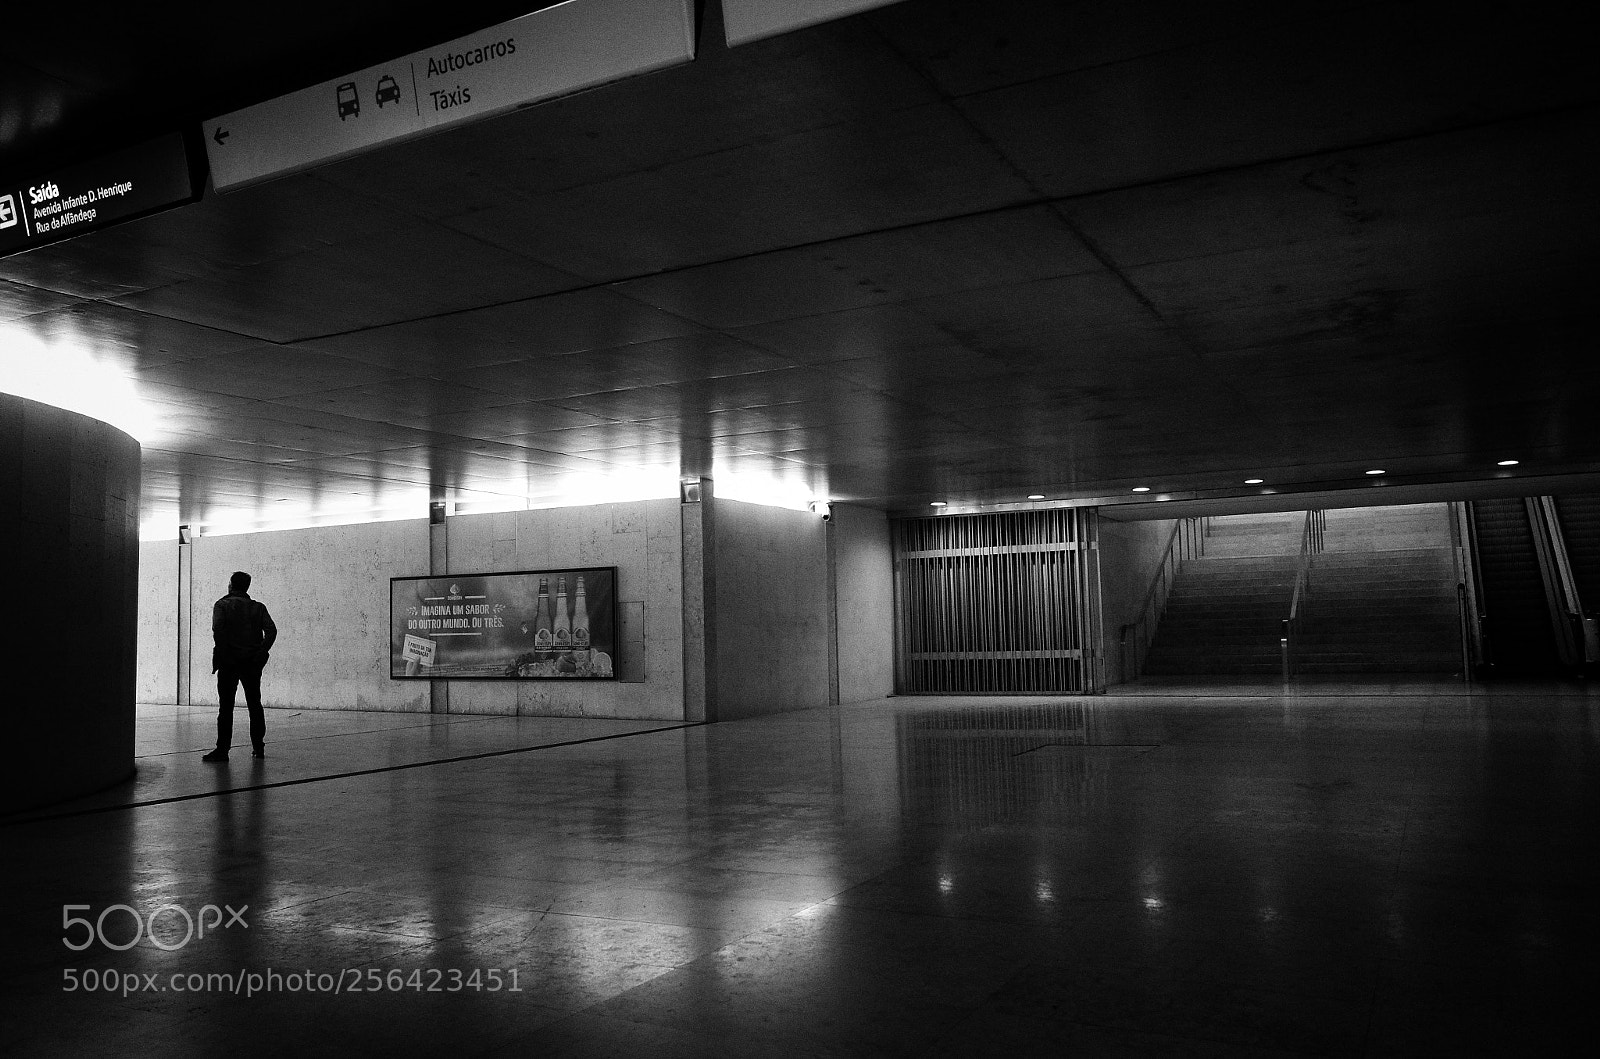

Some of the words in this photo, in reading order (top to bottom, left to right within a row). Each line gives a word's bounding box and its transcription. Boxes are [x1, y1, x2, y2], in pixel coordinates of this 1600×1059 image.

[427, 37, 516, 78] Autocarros
[430, 85, 471, 112] Táxis
[29, 181, 59, 204] Saída
[33, 201, 62, 219] Avenida
[62, 194, 88, 211] Infante
[88, 190, 98, 202] D.
[97, 181, 132, 199] Henrique
[36, 221, 50, 234] Rua
[51, 217, 60, 230] da
[60, 207, 97, 227] Alfândega
[408, 619, 417, 630] DO
[418, 619, 441, 629] OUTRO
[442, 618, 470, 629] MUNDO.
[472, 617, 482, 628] OU
[484, 615, 505, 628] TRÊS.
[421, 605, 451, 616] IMAGINA
[452, 605, 464, 615] UM
[465, 604, 490, 615] SABOR
